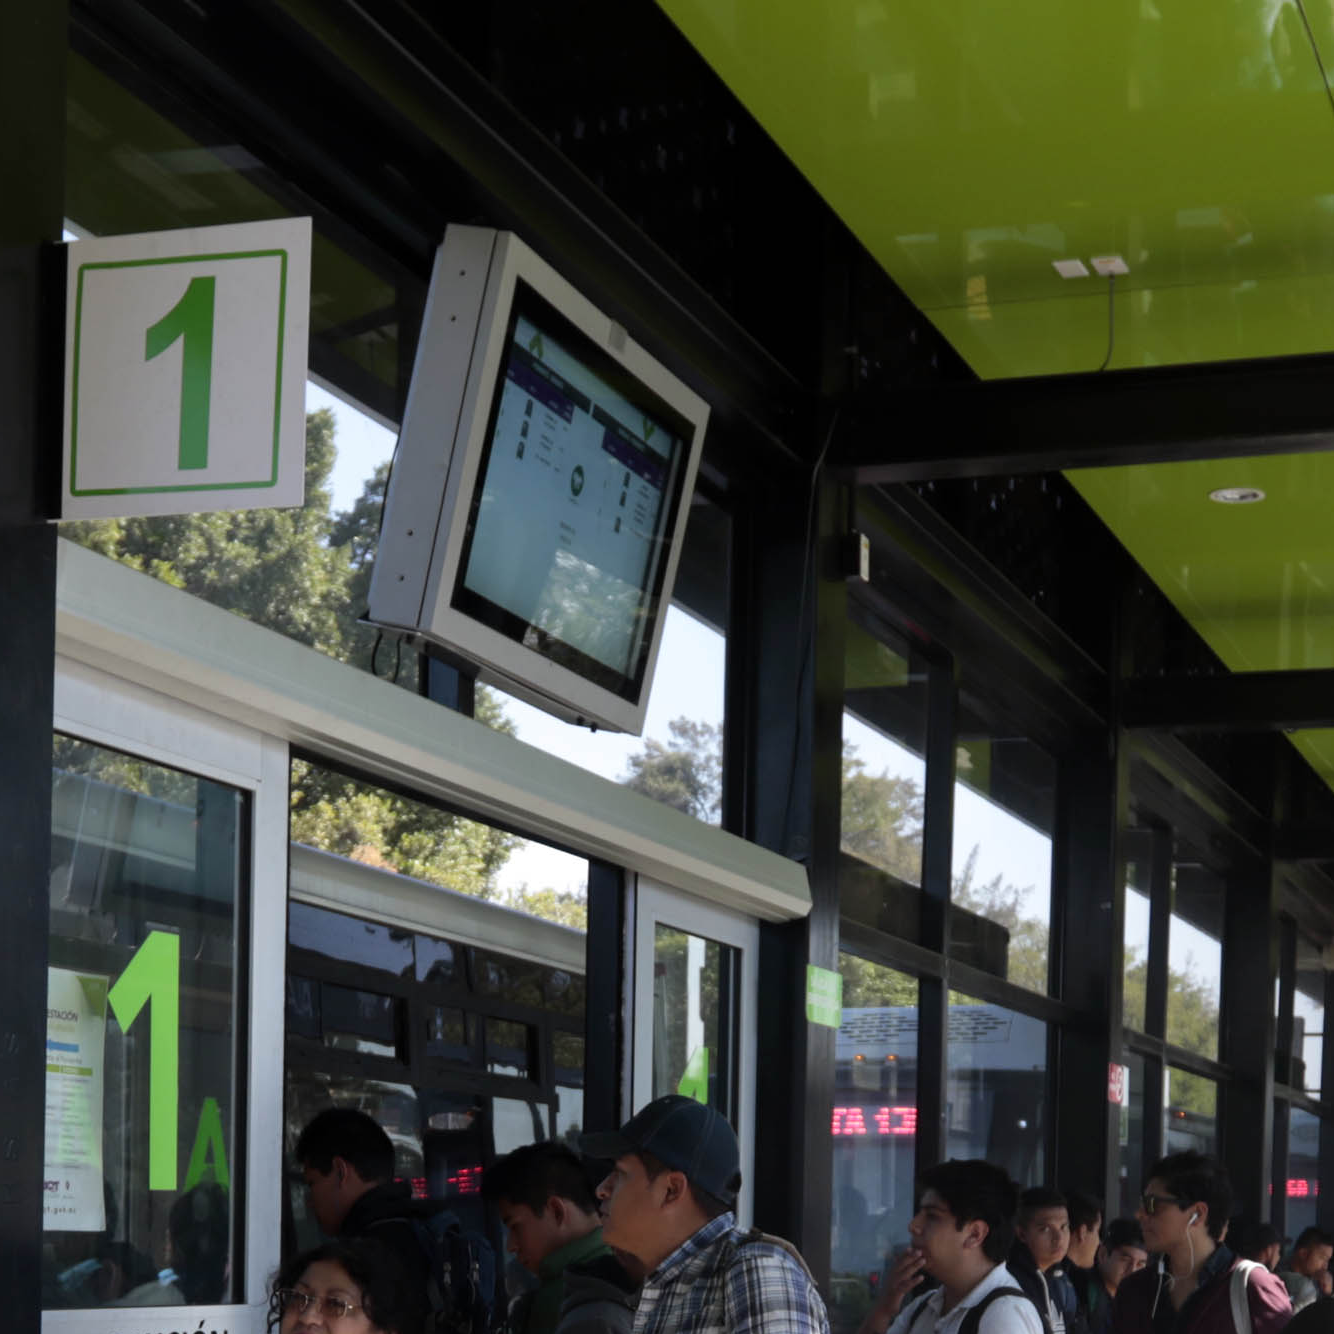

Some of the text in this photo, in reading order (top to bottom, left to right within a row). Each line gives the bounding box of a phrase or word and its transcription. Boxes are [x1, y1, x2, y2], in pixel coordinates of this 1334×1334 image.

[145, 275, 216, 471] 1
[107, 930, 230, 1194] 1 A
